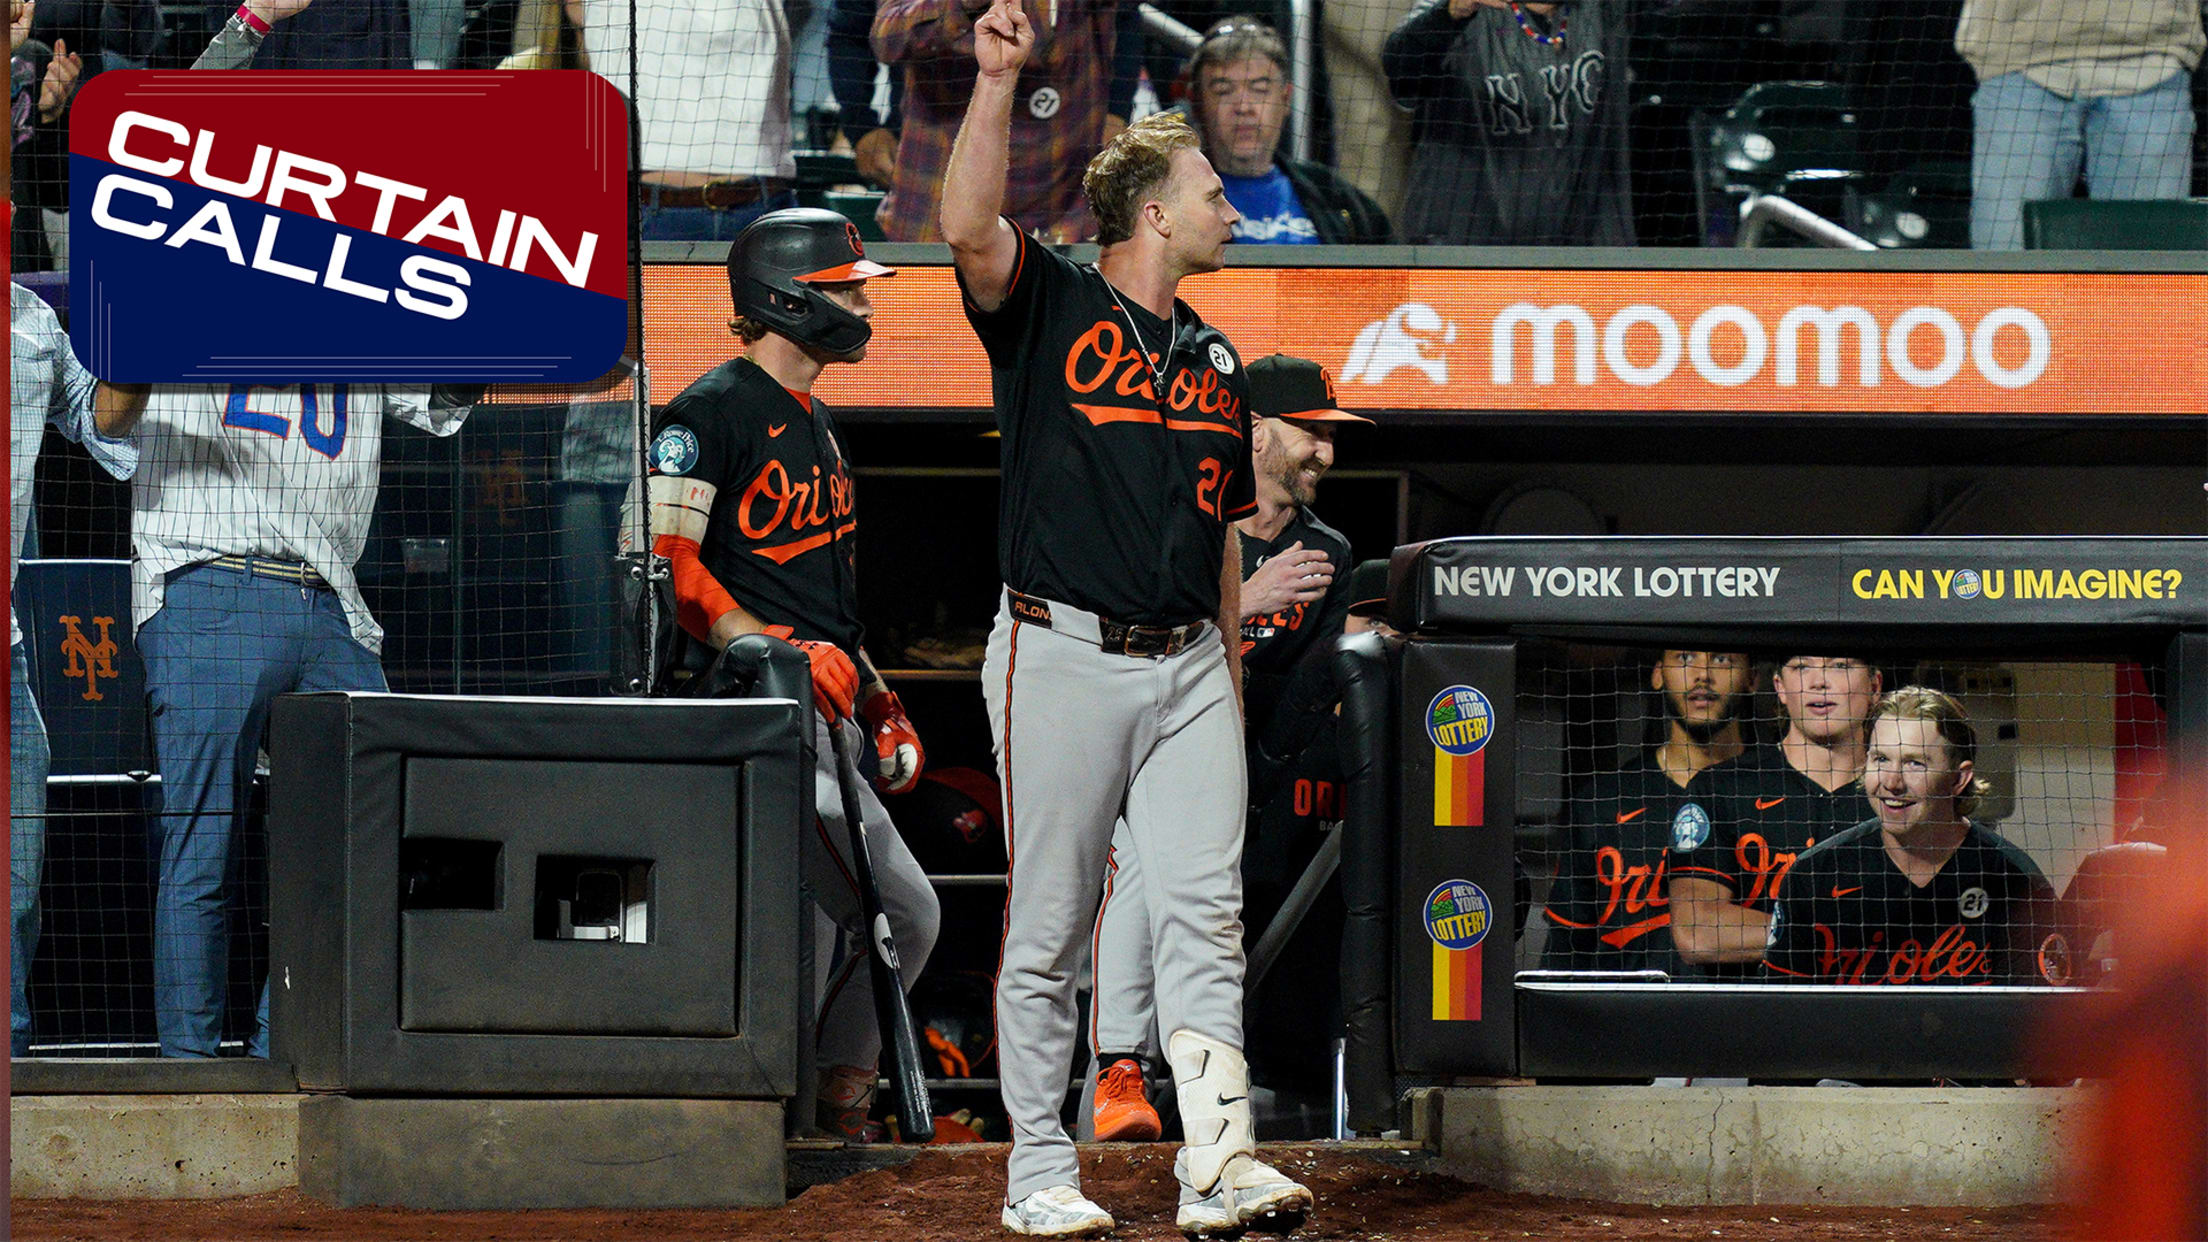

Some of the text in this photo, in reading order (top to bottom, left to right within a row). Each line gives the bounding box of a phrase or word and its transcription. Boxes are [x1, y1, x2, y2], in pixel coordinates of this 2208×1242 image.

[1034, 92, 1055, 112] 21
[1491, 302, 2051, 388] moomoo
[1213, 350, 1228, 366] 21
[1434, 567, 1781, 597] NEW YORK LOTTERY
[1852, 569, 1924, 599] CAN
[2015, 569, 2182, 599] IMAGINE?
[1015, 601, 1053, 620] ALON
[1454, 691, 1479, 704] NEW
[1457, 701, 1487, 719] YORK
[1433, 716, 1488, 746] LOTTERY
[1451, 885, 1476, 898] NEW
[1455, 896, 1485, 913] YORK
[1963, 893, 1985, 911] 21
[1431, 910, 1486, 941] LOTTERY
